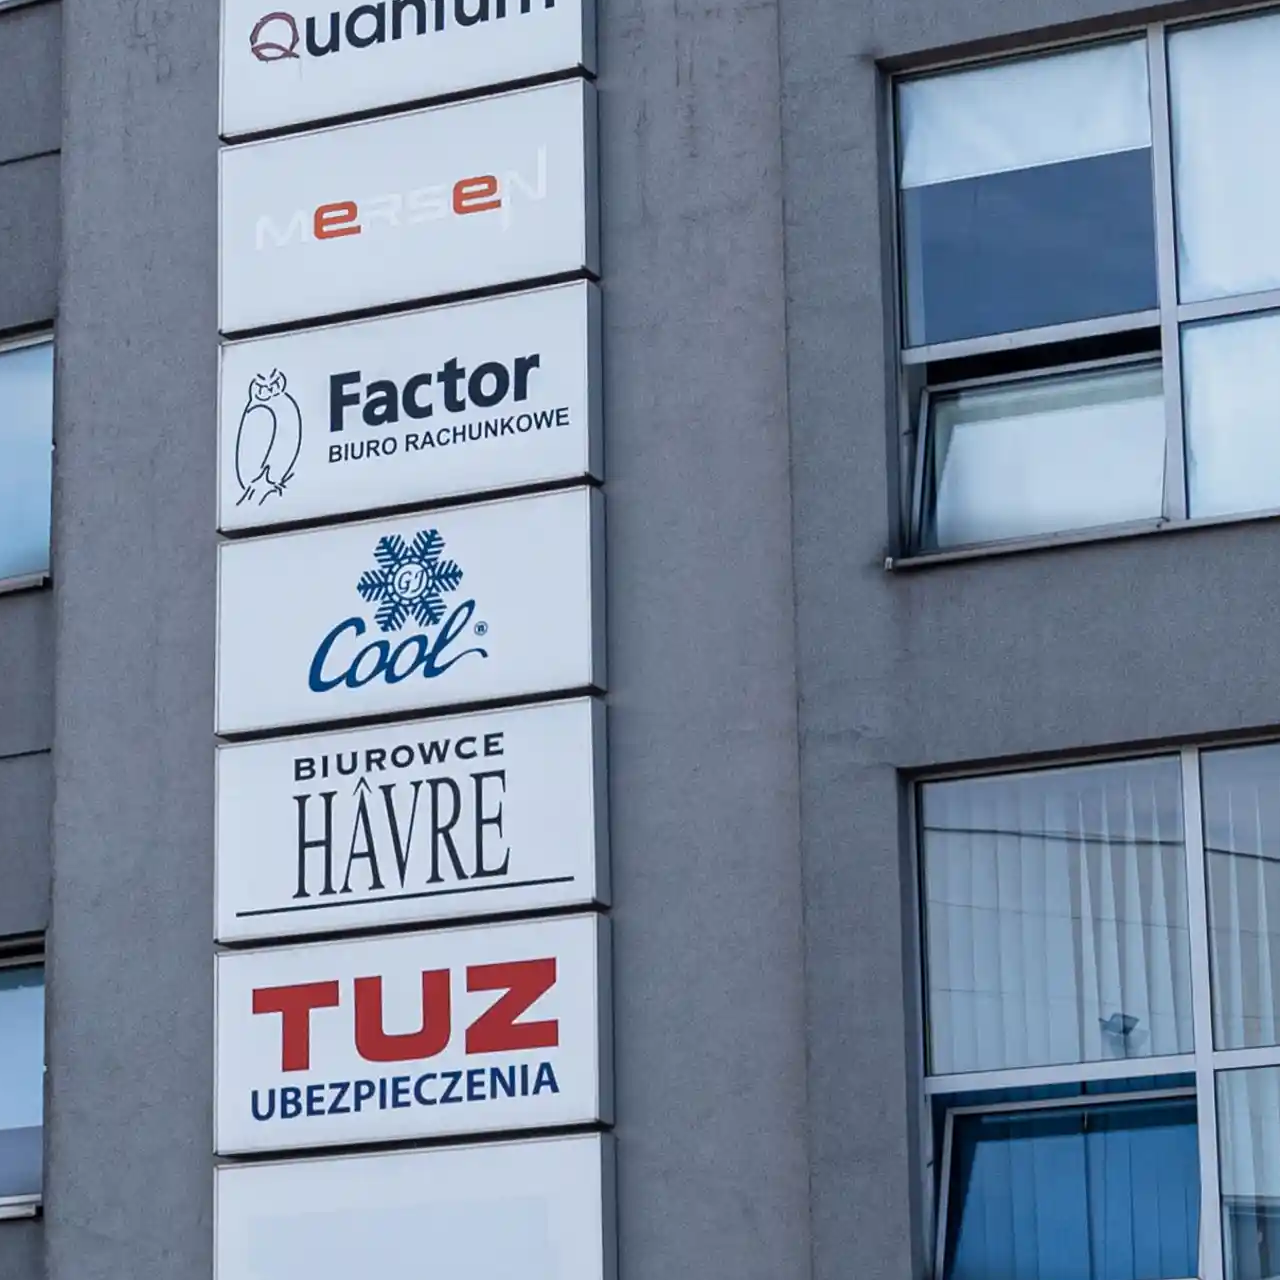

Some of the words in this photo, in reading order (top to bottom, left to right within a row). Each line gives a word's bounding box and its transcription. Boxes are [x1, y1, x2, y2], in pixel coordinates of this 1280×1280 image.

[329, 353, 540, 433] Factor
[328, 436, 398, 464] BIURO
[405, 407, 570, 453] RACHUNKOWE
[308, 599, 488, 693] Cool
[294, 731, 505, 782] BIUROWCE
[292, 769, 511, 899] HÂVRE
[252, 957, 559, 1073] TUZ
[251, 1061, 560, 1122] UBEZPIECZENIA
